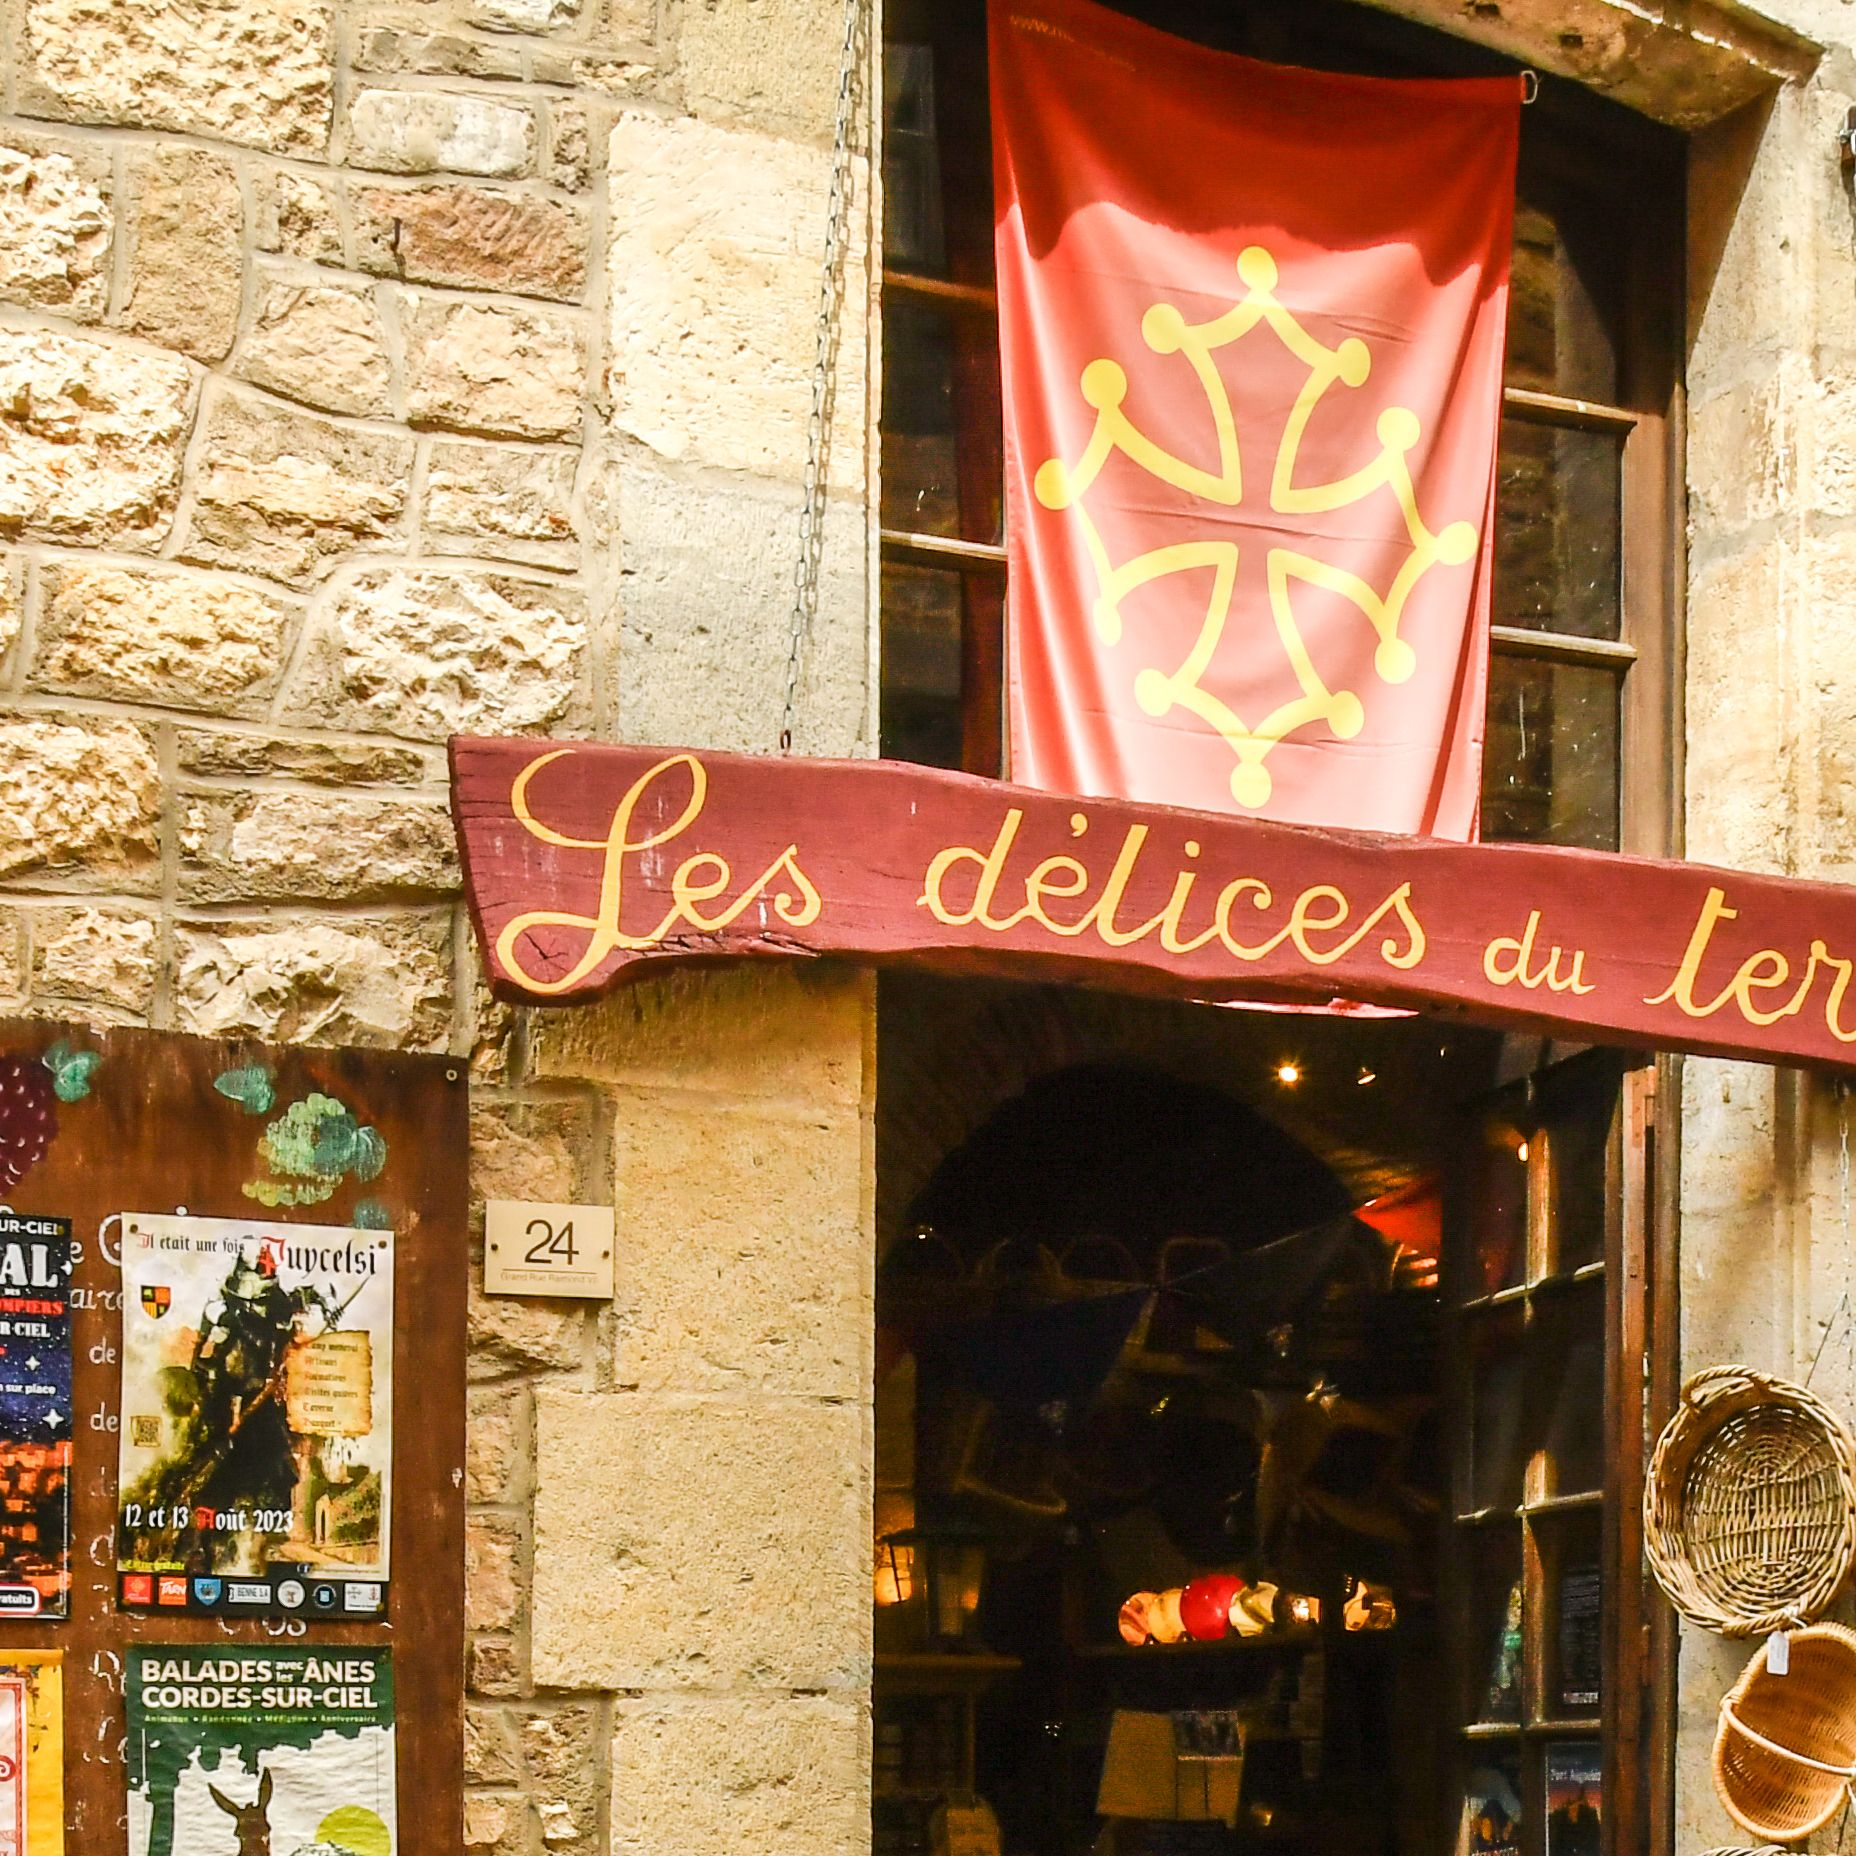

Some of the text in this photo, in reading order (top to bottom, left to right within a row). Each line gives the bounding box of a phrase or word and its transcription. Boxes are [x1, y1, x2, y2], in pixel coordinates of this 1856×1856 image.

[493, 747, 825, 996] Les
[916, 808, 1428, 972] délices
[1480, 907, 1597, 997] du
[195, 1239, 217, 1252] une
[524, 1219, 579, 1265] 24
[6, 1383, 24, 1393] sur
[25, 1383, 57, 1396] place
[125, 1503, 142, 1527] 12
[148, 1506, 165, 1528] et
[172, 1505, 188, 1530] 13
[253, 1510, 293, 1533] 2023
[141, 1659, 273, 1683] BALADES
[275, 1661, 304, 1671] avec
[302, 1656, 376, 1684] ÂNES
[276, 1672, 294, 1684] les
[141, 1686, 378, 1709] CORDES-SUR-CIEL
